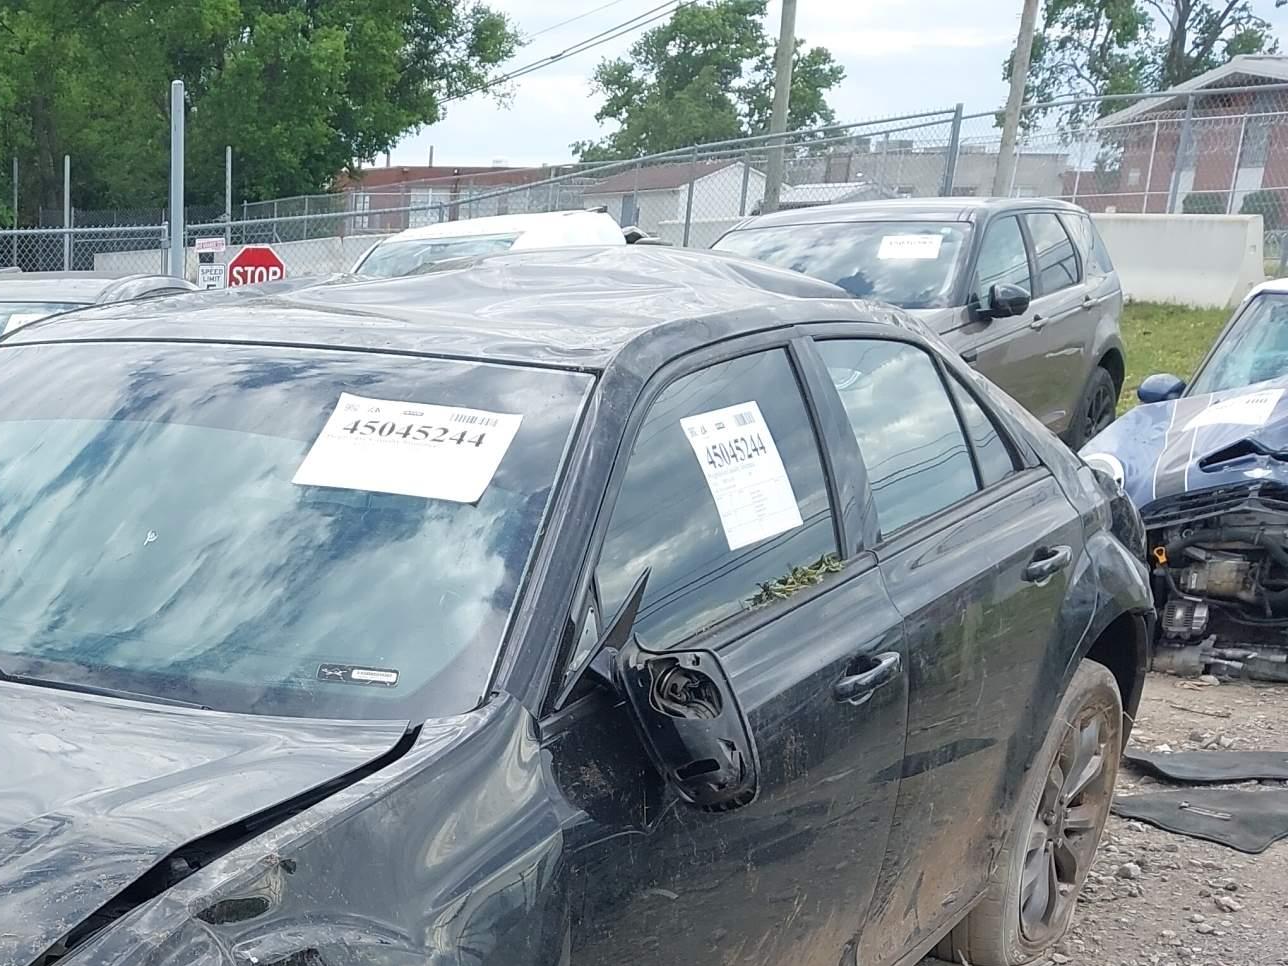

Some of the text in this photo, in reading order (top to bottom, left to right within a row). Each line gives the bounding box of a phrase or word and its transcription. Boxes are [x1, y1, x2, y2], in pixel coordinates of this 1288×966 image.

[232, 267, 281, 287] STOP
[343, 419, 487, 448] 45045244
[705, 432, 767, 469] 45045244
